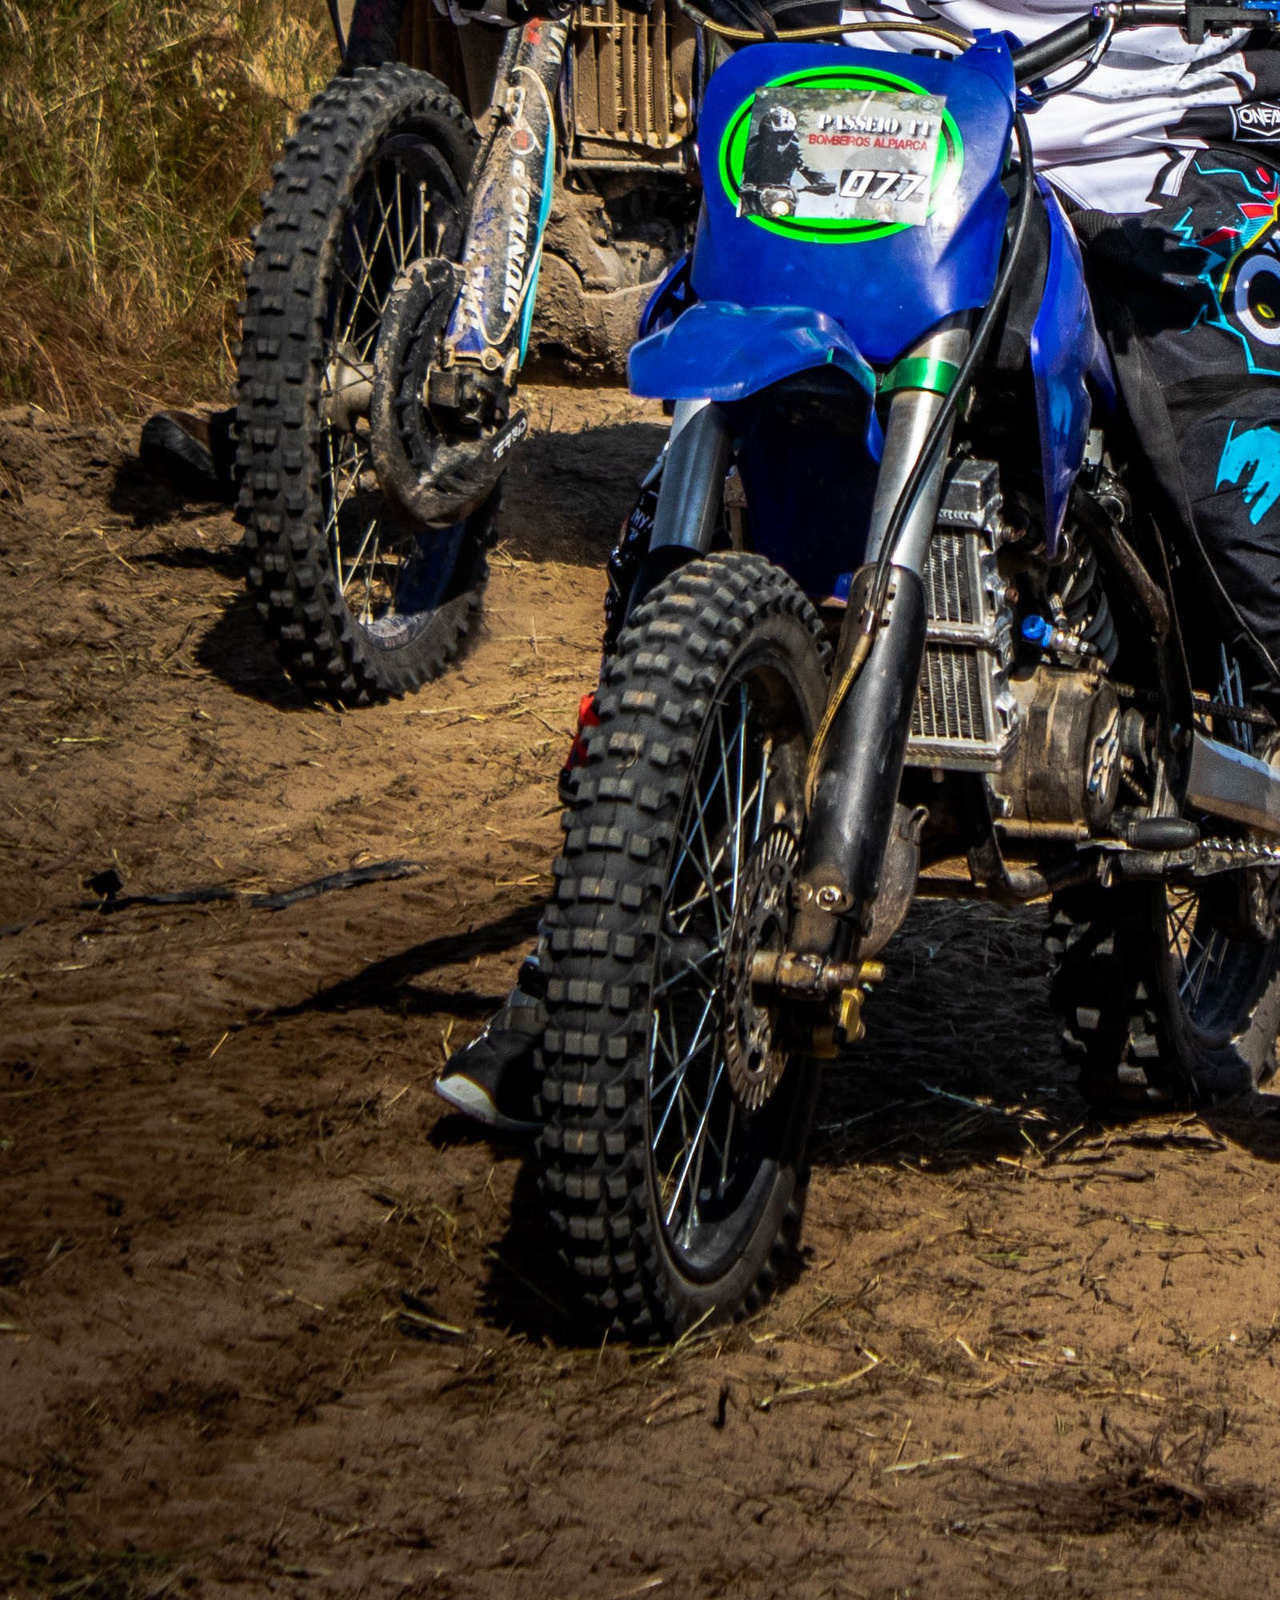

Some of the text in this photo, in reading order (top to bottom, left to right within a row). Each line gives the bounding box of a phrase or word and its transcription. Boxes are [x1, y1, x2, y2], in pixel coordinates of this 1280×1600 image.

[816, 113, 933, 137] PASSEIO TT
[808, 134, 871, 147] BOMBEIROS
[839, 169, 928, 202] 077
[504, 159, 530, 315] DUNLOP
